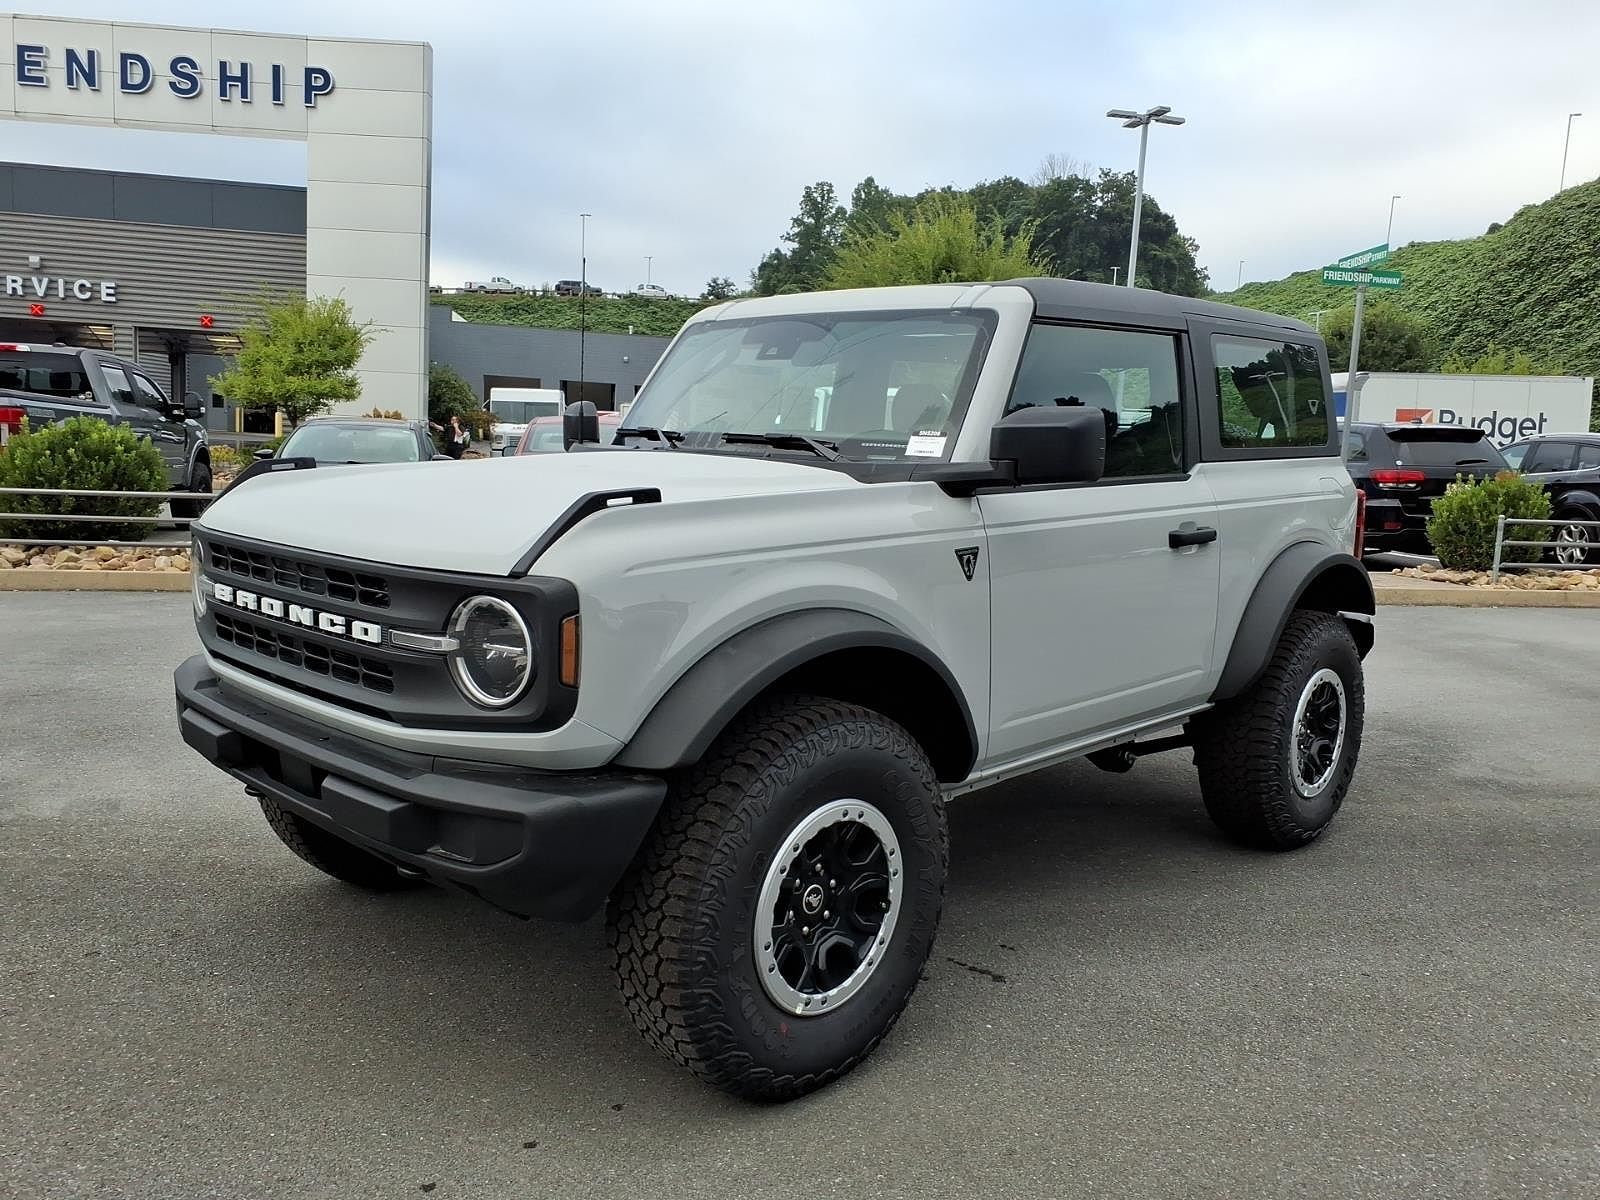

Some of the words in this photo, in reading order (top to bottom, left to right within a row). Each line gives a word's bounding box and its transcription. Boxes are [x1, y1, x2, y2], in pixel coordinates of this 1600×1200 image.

[16, 43, 334, 108] ENDSHIP
[1372, 251, 1387, 261] STREET
[6, 274, 118, 303] RVICE
[1323, 270, 1373, 283] FRIENDSHIP
[1373, 276, 1400, 285] PARKWAY
[214, 583, 382, 644] BRONCO
